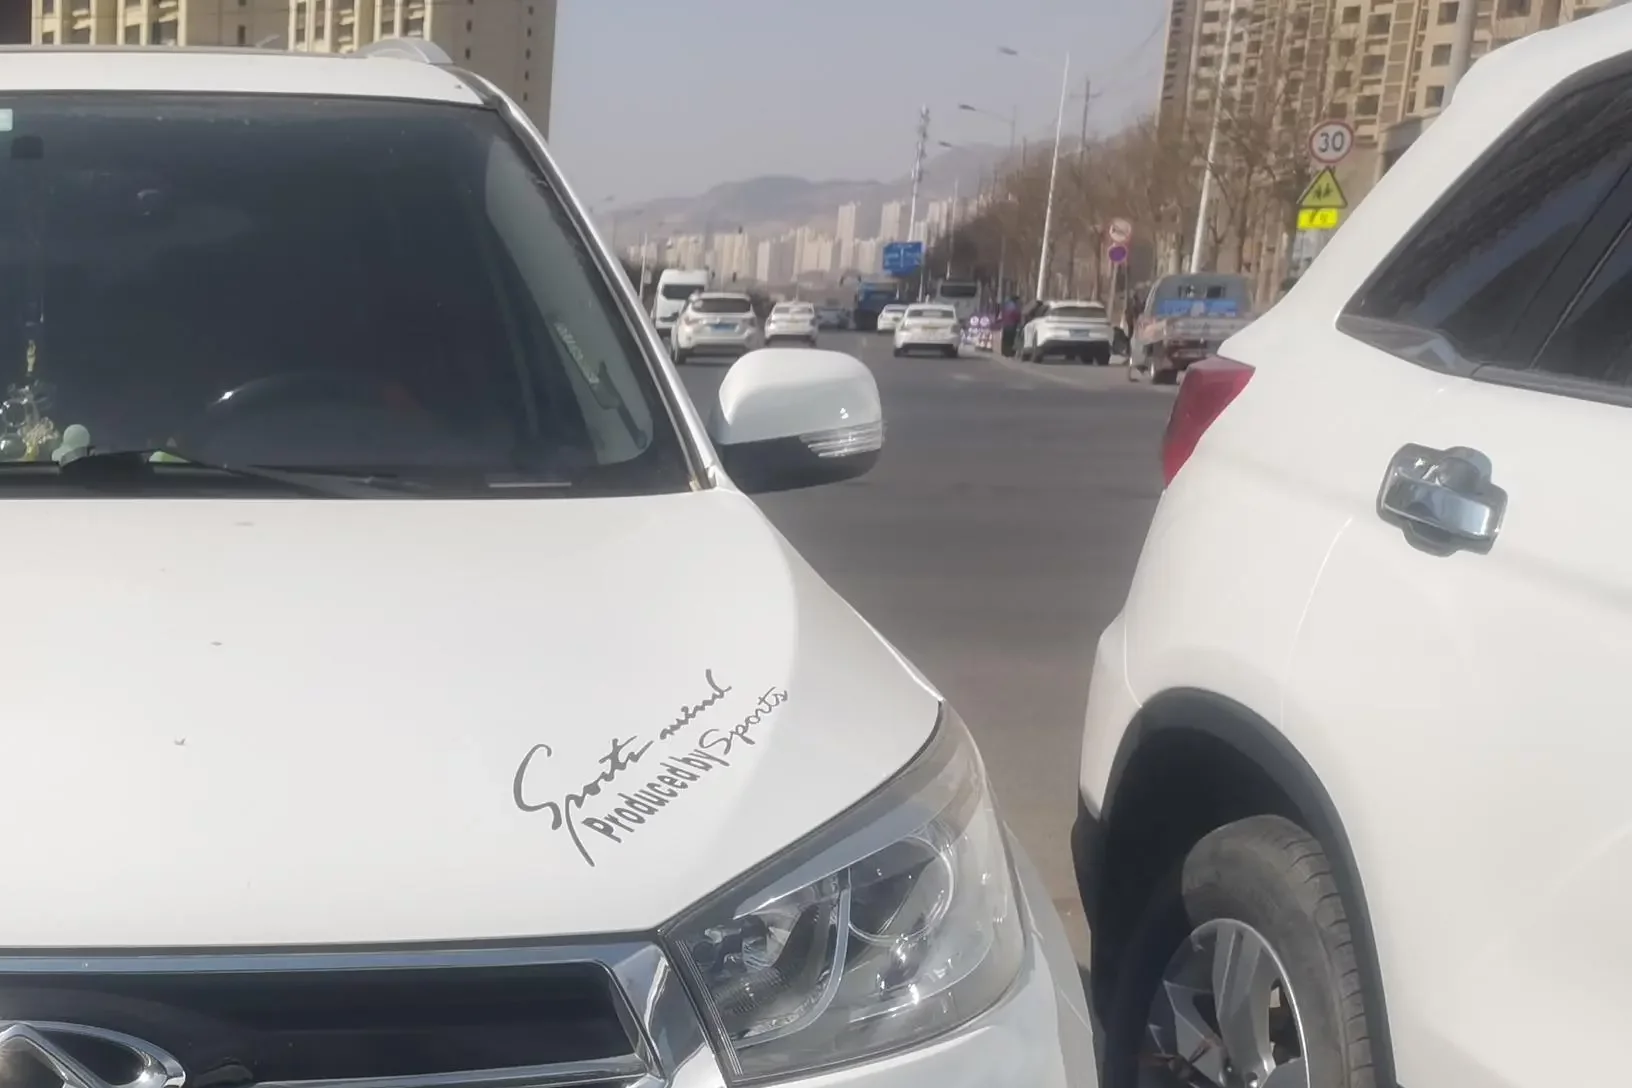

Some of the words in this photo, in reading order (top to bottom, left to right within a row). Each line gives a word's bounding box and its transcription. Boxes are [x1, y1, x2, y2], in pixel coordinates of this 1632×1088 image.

[1320, 131, 1345, 152] 30
[581, 762, 700, 843] Produced
[668, 748, 730, 772] by
[699, 686, 788, 755] Sports
